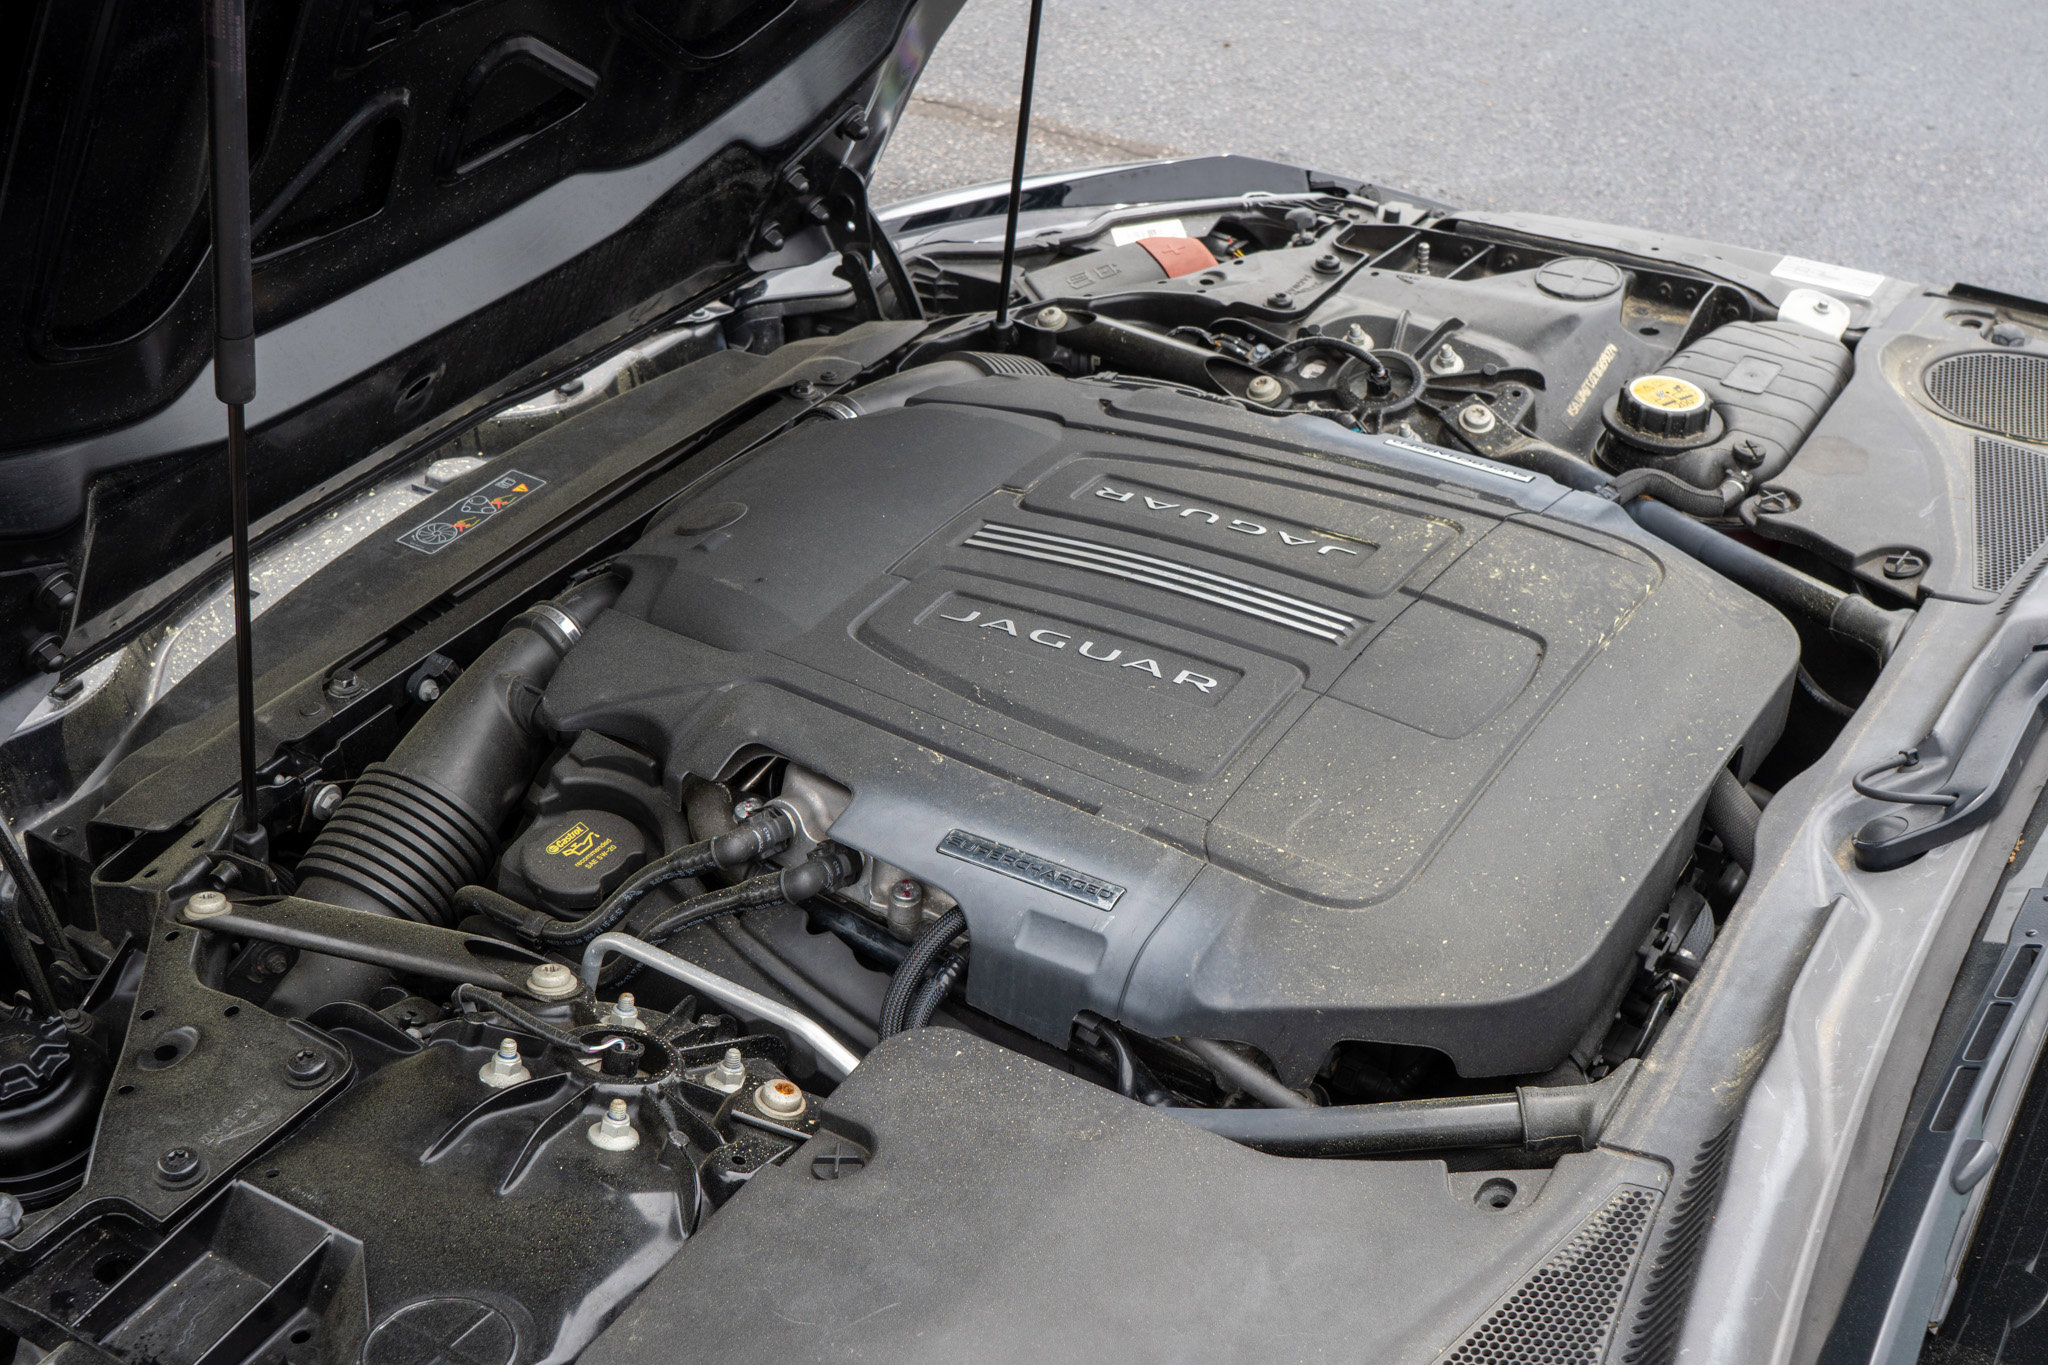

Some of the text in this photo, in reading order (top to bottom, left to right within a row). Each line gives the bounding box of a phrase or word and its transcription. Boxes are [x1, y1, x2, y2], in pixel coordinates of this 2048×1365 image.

[1095, 486, 1358, 556] JAGUAR
[940, 611, 1218, 694] JAGUAR
[556, 826, 584, 848] Castrol
[574, 838, 613, 867] recommended
[585, 858, 599, 870] SAE
[947, 836, 1114, 900] SUPERCHARGED
